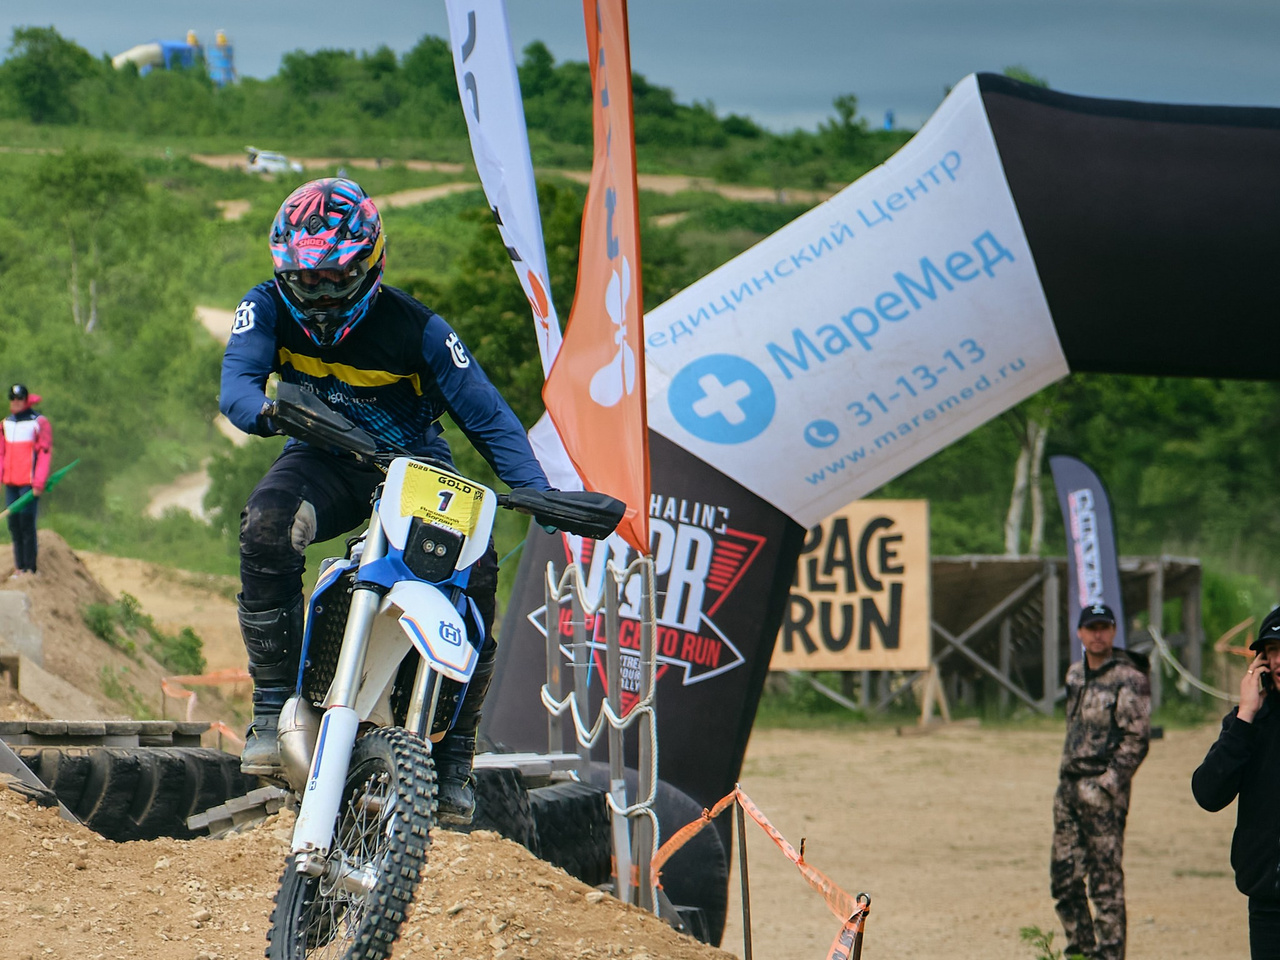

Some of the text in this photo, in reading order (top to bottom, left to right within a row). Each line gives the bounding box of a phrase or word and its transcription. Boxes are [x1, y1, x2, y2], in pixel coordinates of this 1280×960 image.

[299, 238, 325, 247] SHOEI
[645, 150, 962, 352] едицинский Центр
[765, 230, 1016, 381] МареМед
[846, 338, 987, 428] 31-13-13
[804, 357, 1027, 487] www.maremed.ru
[438, 476, 472, 494] GOLD
[438, 490, 454, 511] 1
[680, 632, 722, 669] RUN
[782, 583, 904, 655] RUN
